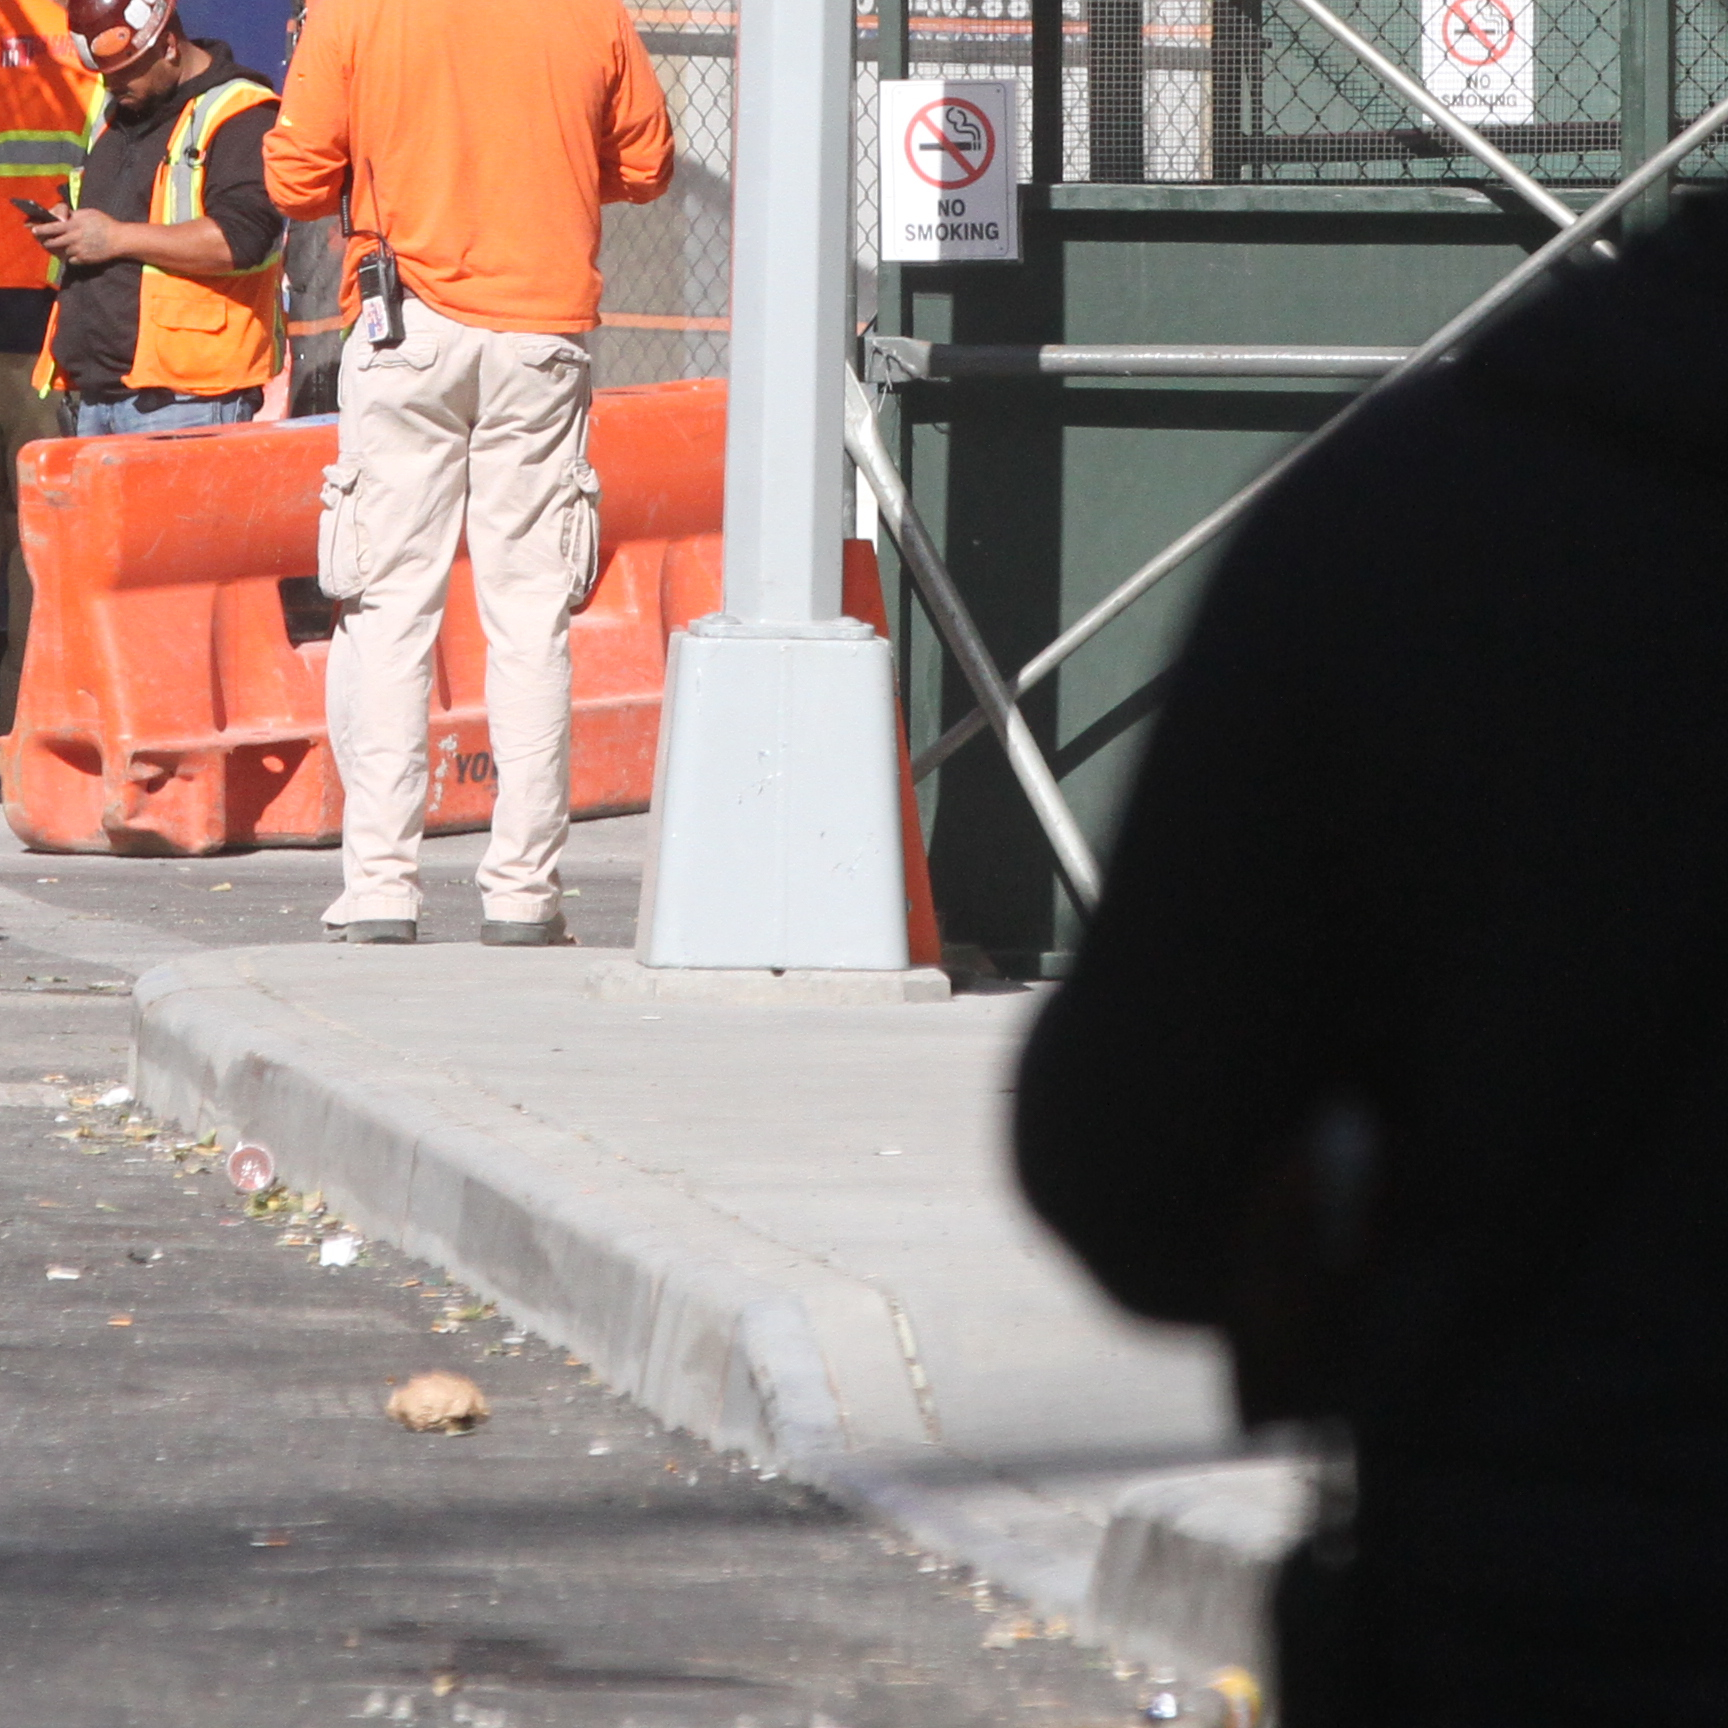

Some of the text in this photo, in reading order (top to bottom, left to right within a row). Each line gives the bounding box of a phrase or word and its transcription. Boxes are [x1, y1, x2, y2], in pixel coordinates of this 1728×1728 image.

[1466, 73, 1491, 89] NO
[1441, 94, 1518, 108] SMOKING
[937, 198, 966, 217] NO
[905, 222, 1000, 242] SMOKING
